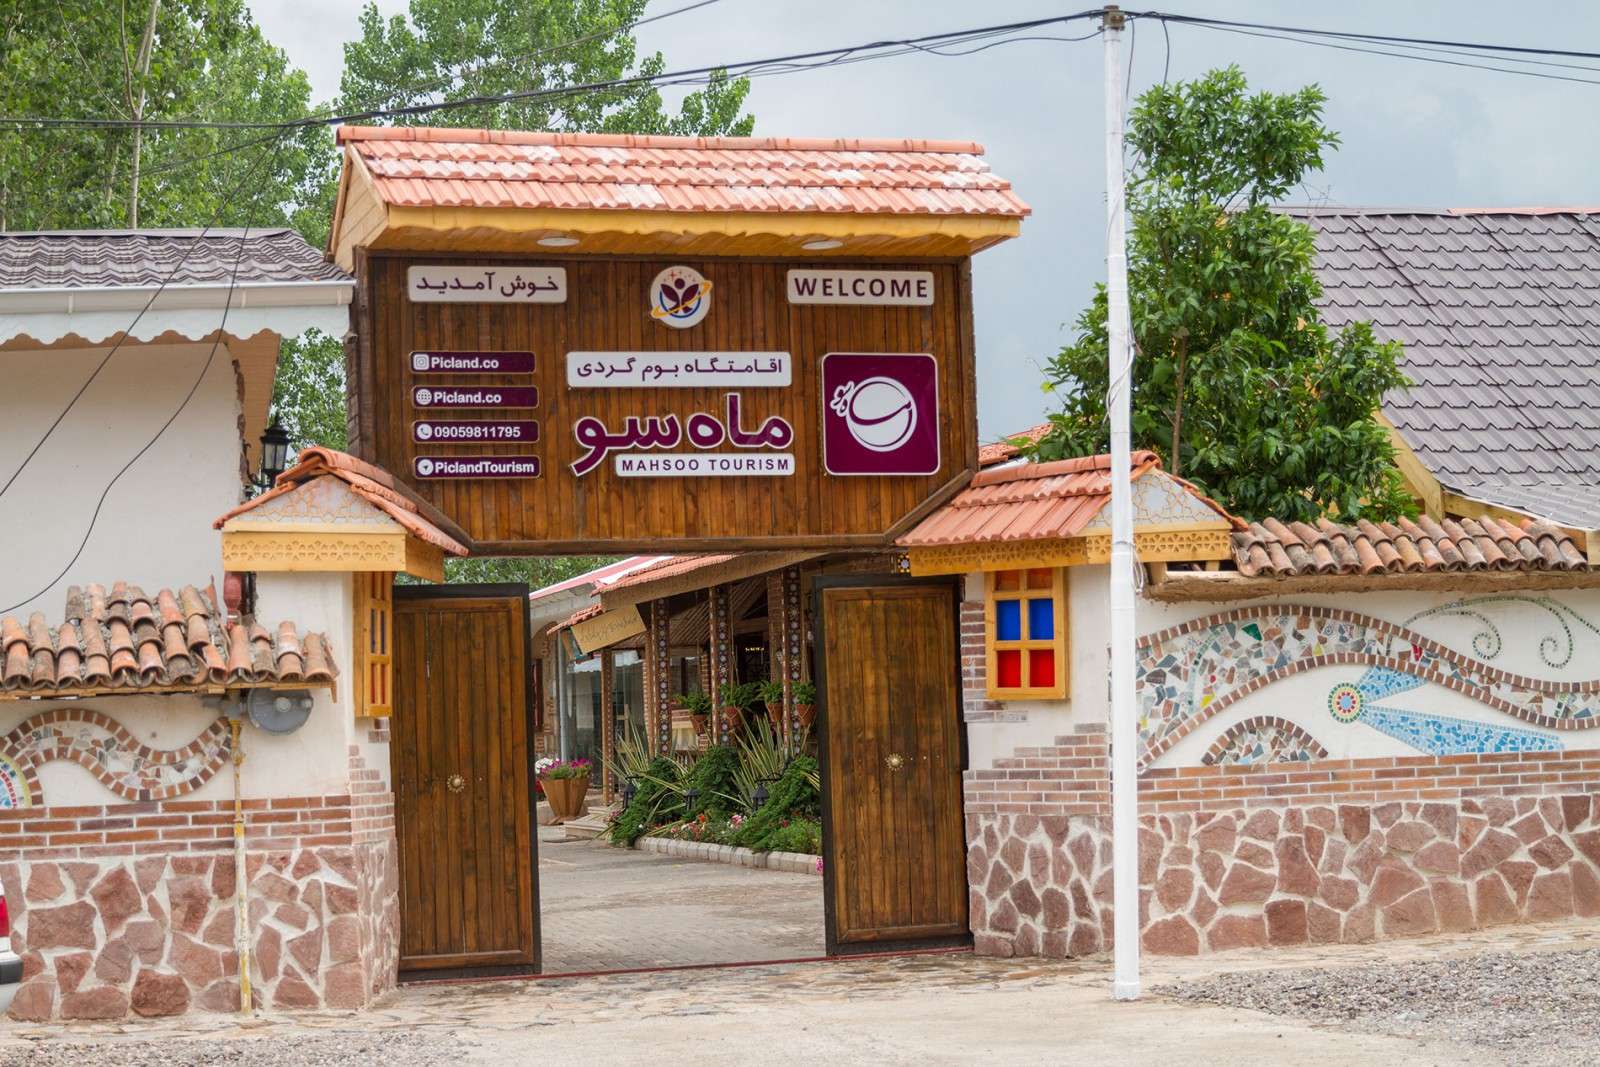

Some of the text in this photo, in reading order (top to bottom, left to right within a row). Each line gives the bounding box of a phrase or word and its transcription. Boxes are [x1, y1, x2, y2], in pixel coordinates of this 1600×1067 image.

[416, 271, 559, 297] خوش آمدید
[794, 277, 928, 298] WELCOME
[431, 356, 500, 369] Picland.co
[576, 356, 783, 382] اقامتگاه بوم گردی
[433, 391, 502, 404] Picland.co
[434, 426, 521, 438] 09059811795
[434, 460, 535, 474] PiclandTourism
[621, 458, 789, 472] MAHSOO TOURISM
